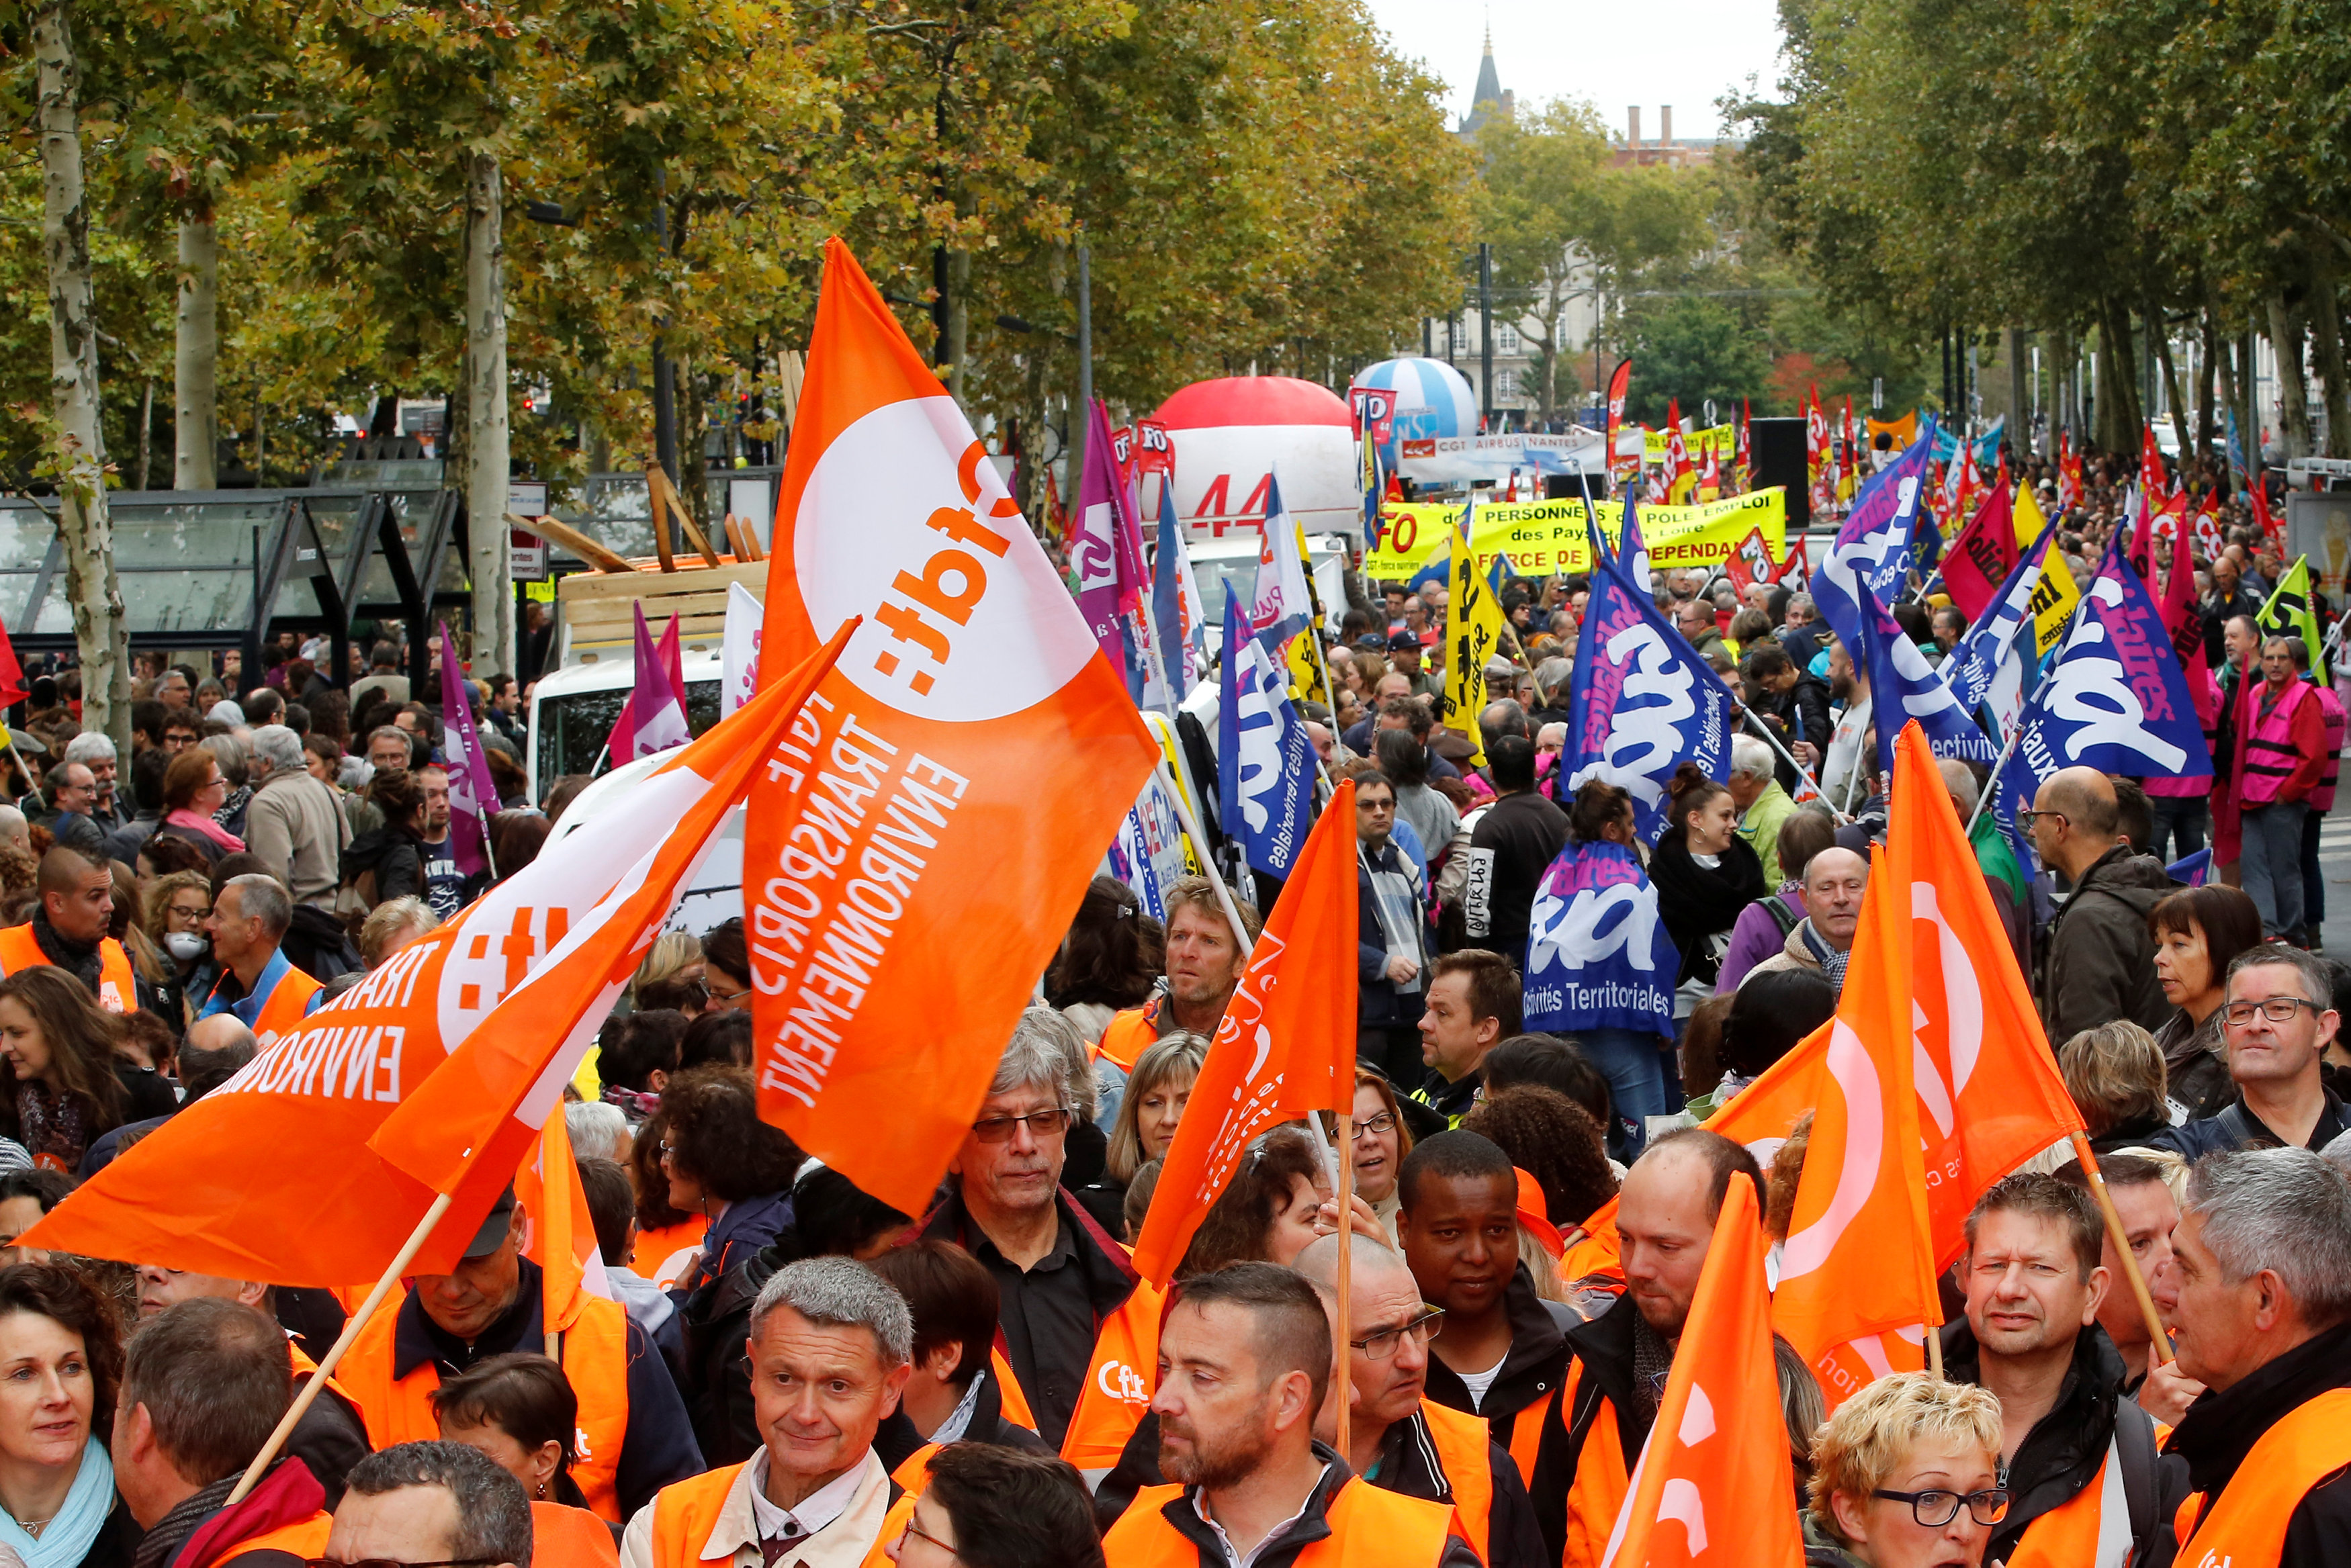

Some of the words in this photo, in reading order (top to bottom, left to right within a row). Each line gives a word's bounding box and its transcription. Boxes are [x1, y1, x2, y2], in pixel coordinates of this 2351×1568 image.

[1143, 426, 1167, 452] FO
[1438, 442, 1466, 451] CGT
[1476, 437, 1520, 449] AIRBUS
[1529, 437, 1578, 447] NANTES
[1485, 506, 1606, 522] PERSONNES
[1646, 512, 1693, 524] PÔLE
[1705, 496, 1769, 516] EMPLOI
[1511, 528, 1544, 541] des
[1553, 527, 1589, 541] Pays
[1660, 523, 1704, 537] Loire
[1558, 550, 1582, 565] DE
[1565, 980, 1669, 1017] Territoriales
